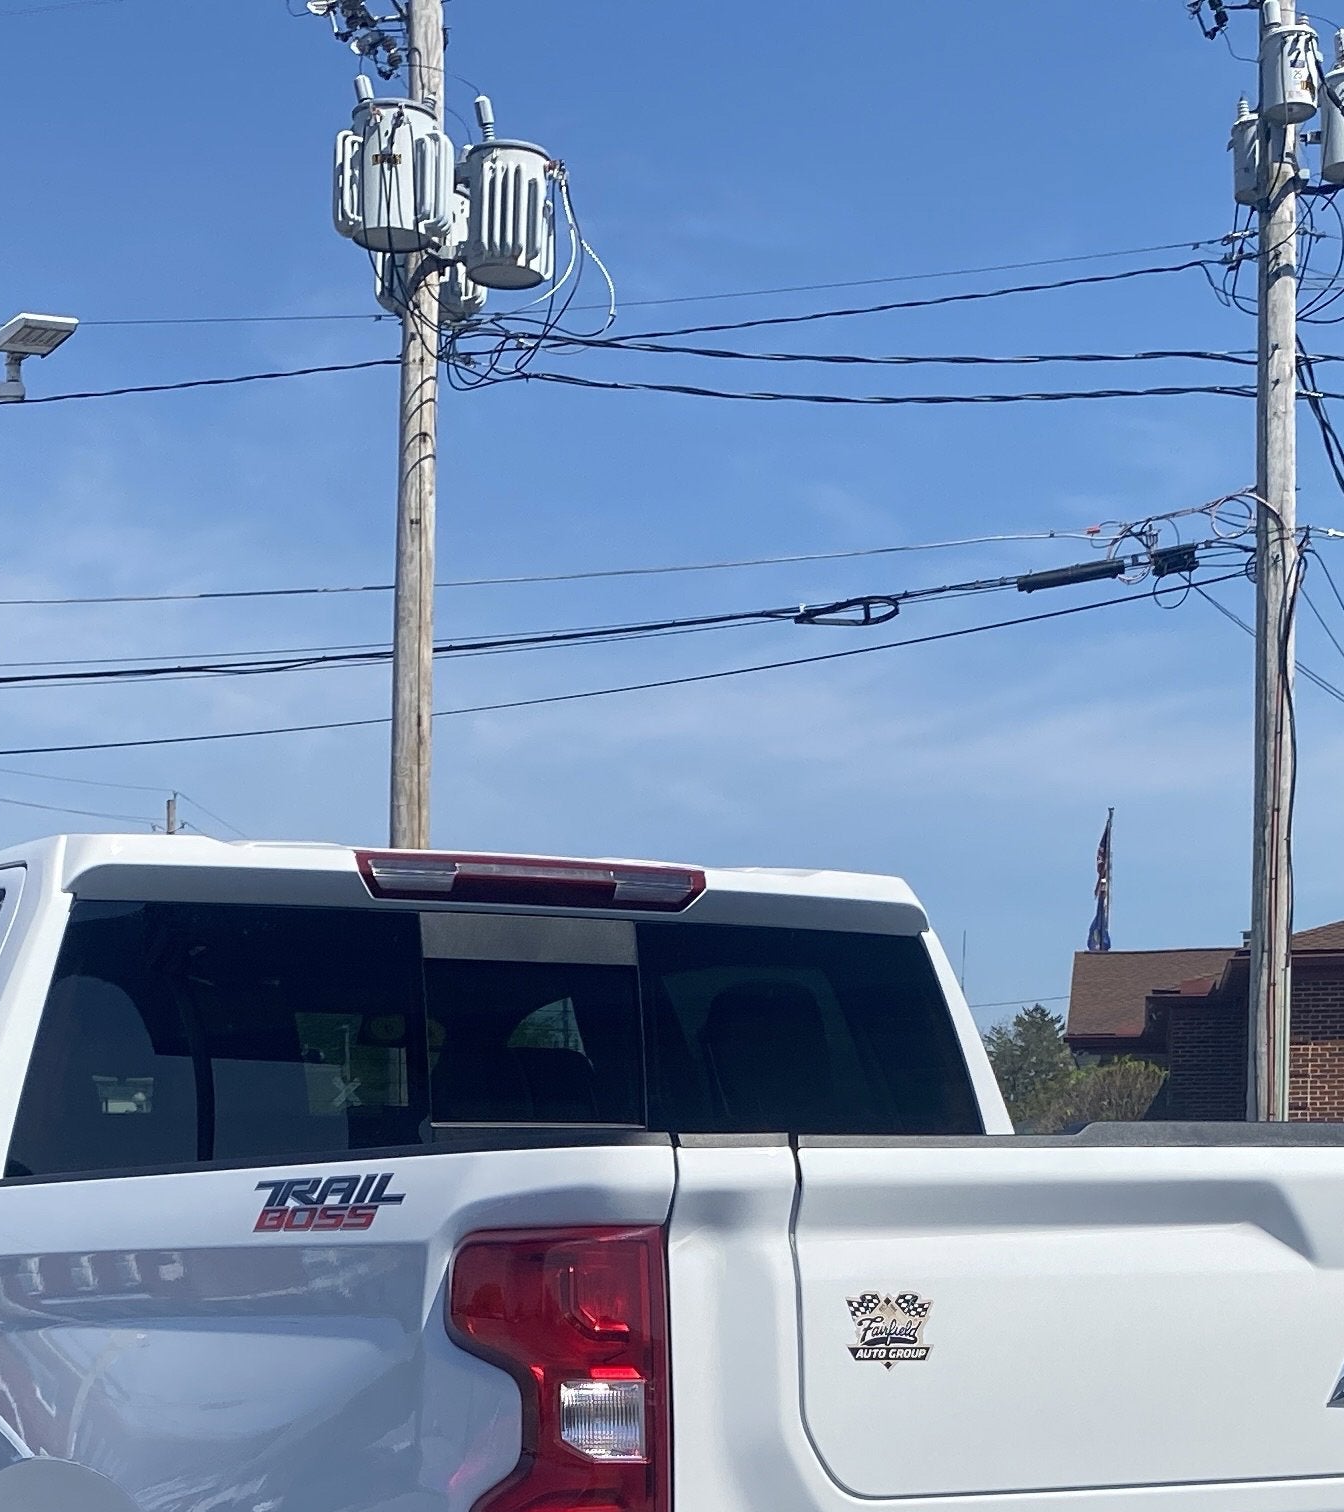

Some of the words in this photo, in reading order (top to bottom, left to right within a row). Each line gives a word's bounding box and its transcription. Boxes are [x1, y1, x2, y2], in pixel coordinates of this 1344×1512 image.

[254, 1172, 407, 1207] TRAIL
[252, 1204, 380, 1233] BOSS
[856, 1316, 923, 1347] Fairfield
[855, 1348, 887, 1359] AUTO
[888, 1348, 927, 1359] GROUP
